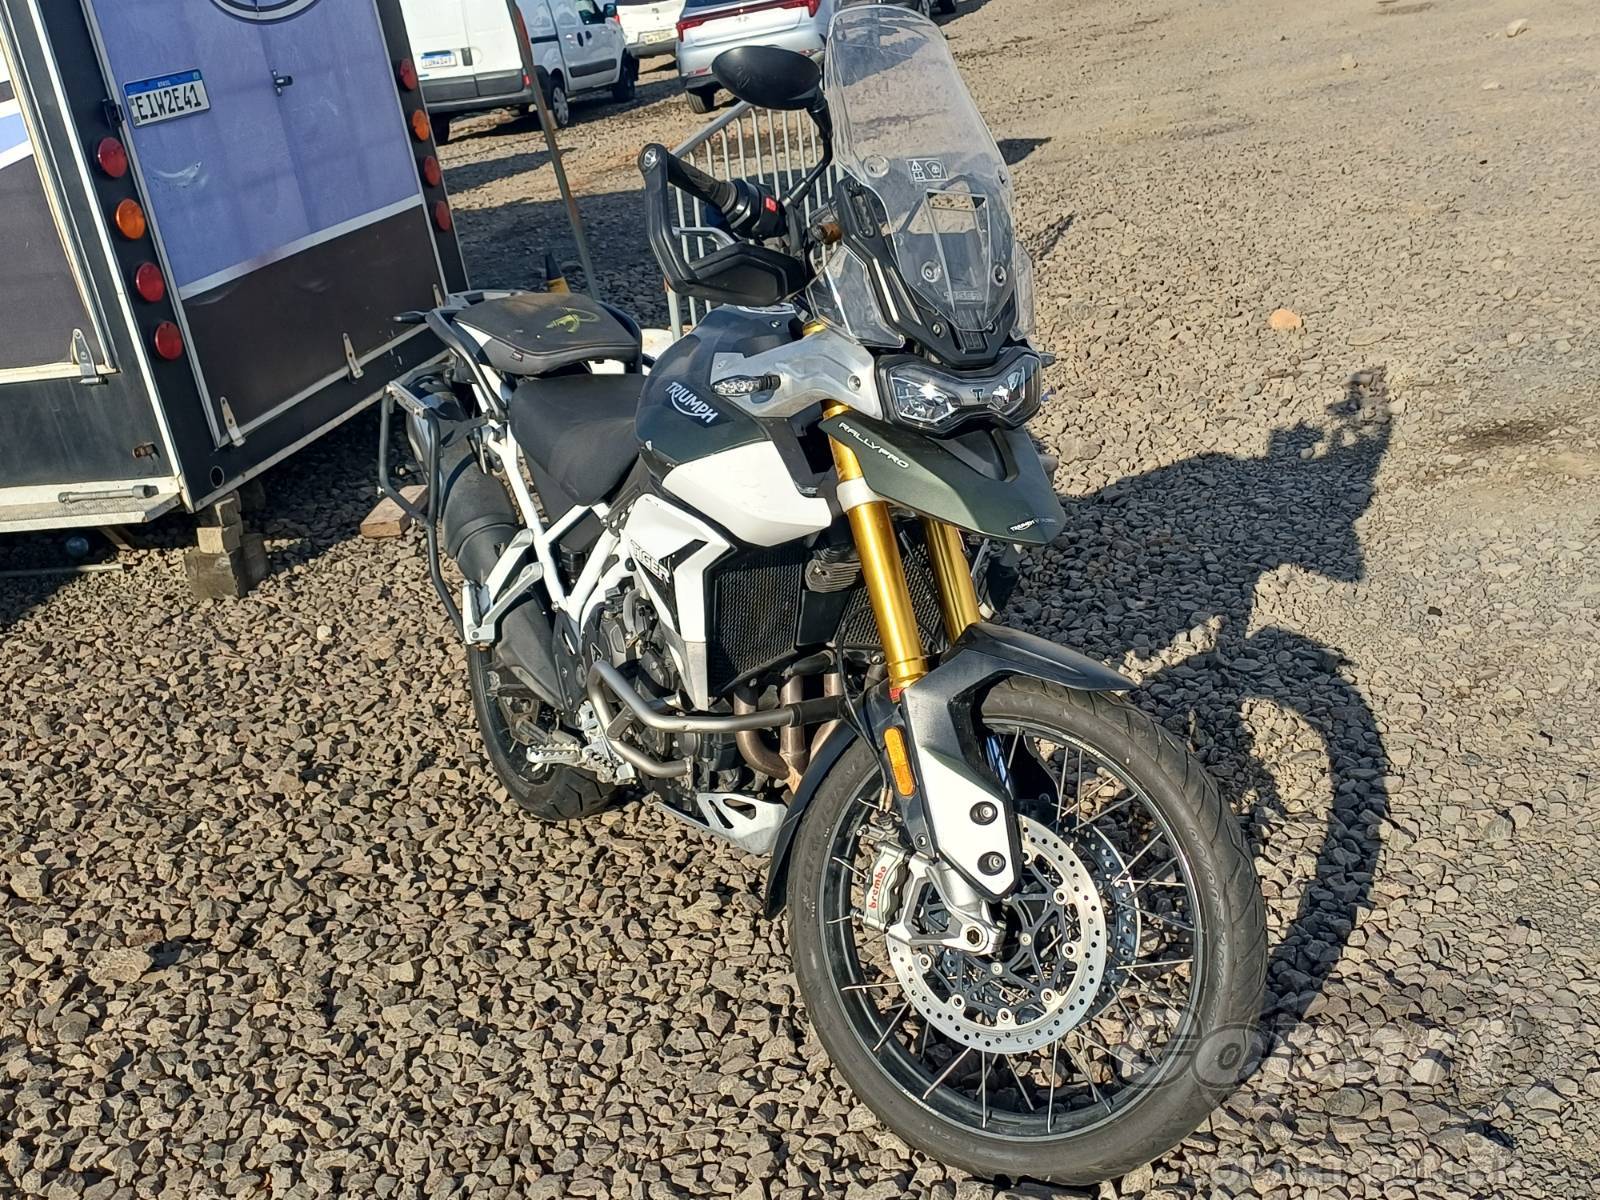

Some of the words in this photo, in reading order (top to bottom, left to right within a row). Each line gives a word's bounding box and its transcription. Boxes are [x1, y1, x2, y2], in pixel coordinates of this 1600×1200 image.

[135, 84, 202, 121] EIW2E41
[665, 381, 719, 423] TRIUMPH
[868, 866, 887, 909] brembo
